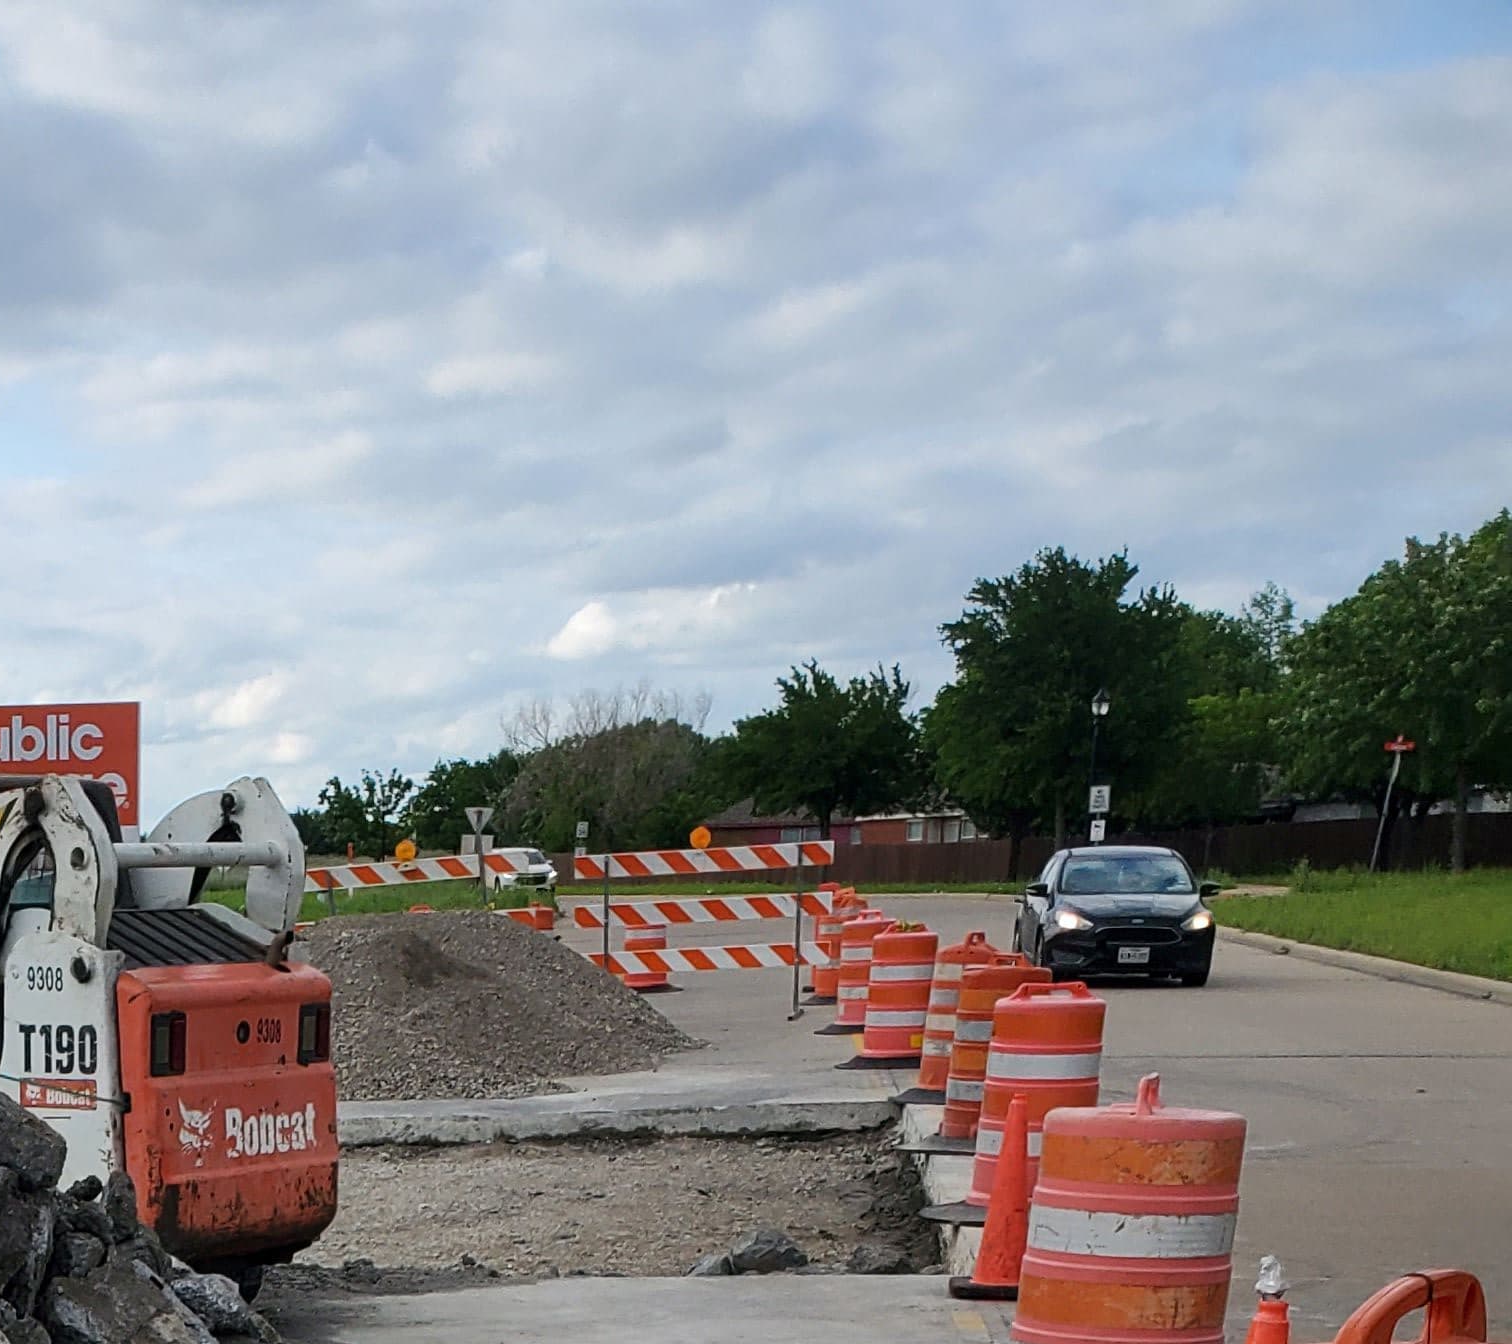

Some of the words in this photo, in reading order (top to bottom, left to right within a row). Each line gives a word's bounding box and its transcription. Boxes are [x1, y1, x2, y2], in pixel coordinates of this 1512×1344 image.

[27, 966, 63, 992] 9308
[19, 1024, 97, 1075] T190
[257, 1017, 281, 1044] 9308
[225, 1103, 317, 1158] Bobcat
